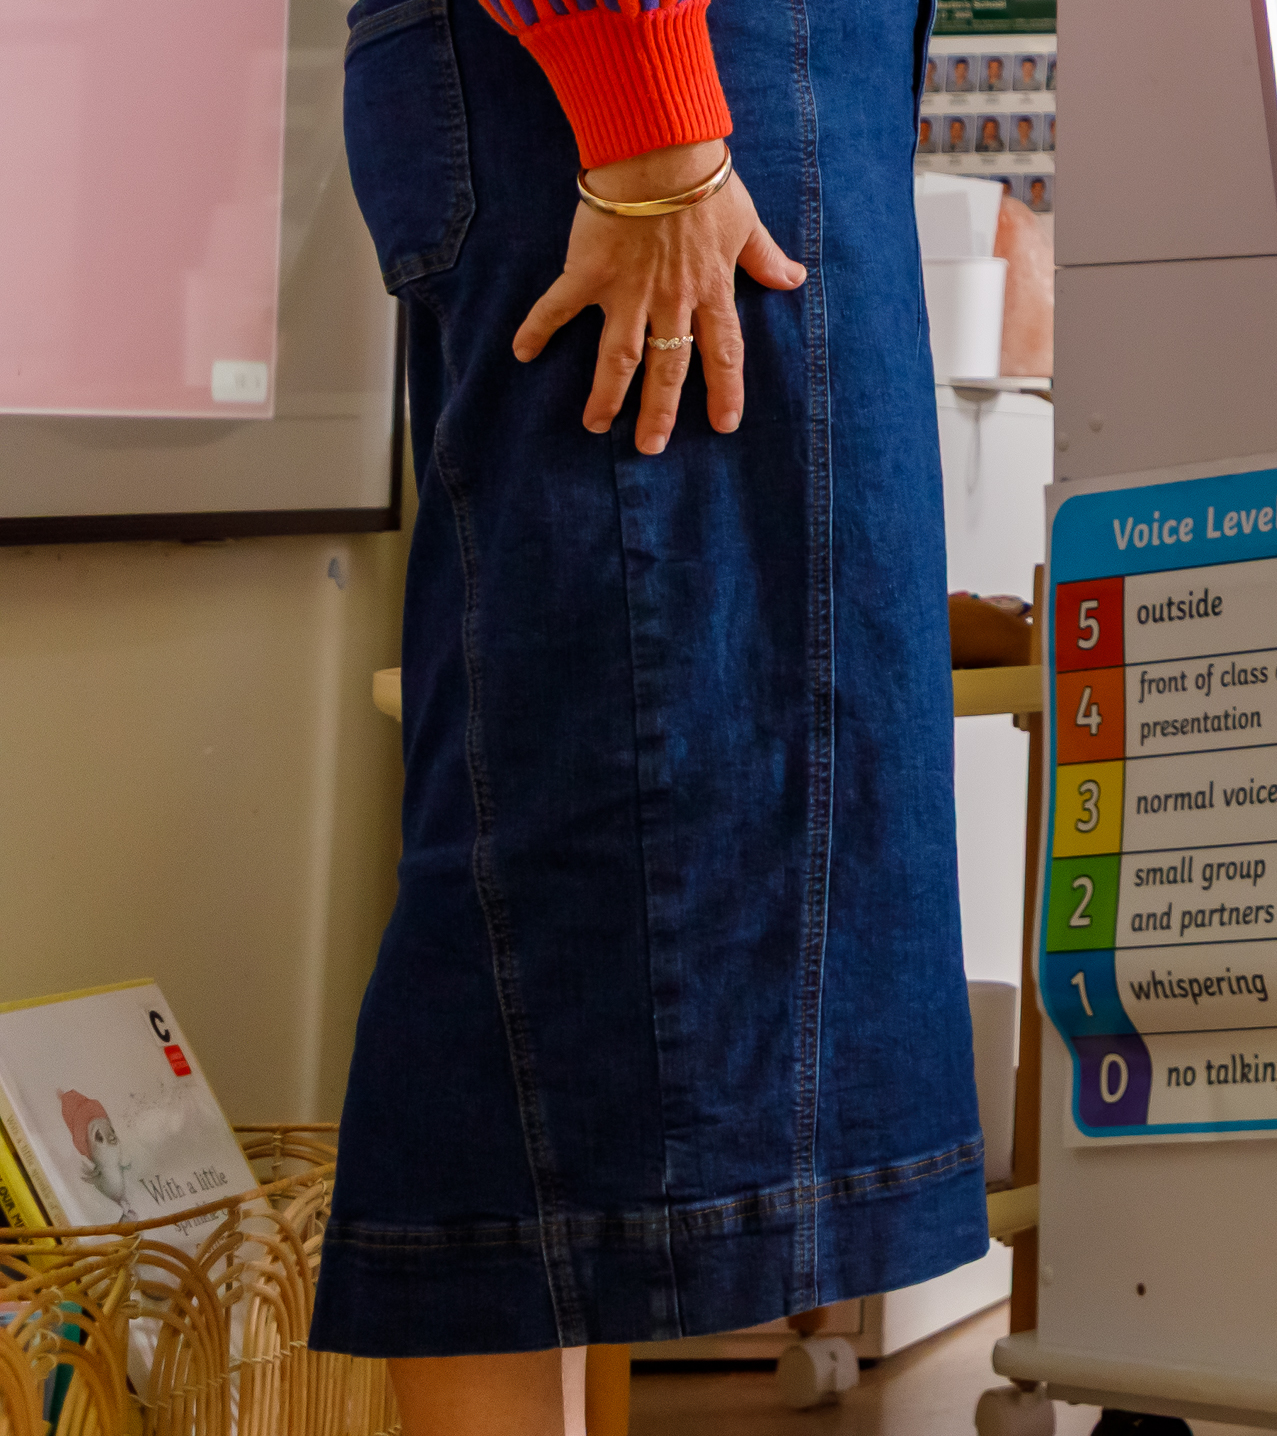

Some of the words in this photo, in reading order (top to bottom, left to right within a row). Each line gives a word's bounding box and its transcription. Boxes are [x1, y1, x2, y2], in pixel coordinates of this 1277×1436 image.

[1113, 510, 1195, 551] Voice
[1076, 598, 1100, 650] 5
[1136, 587, 1224, 625] outside
[1138, 670, 1189, 703] front
[1195, 663, 1215, 697] of
[1220, 661, 1269, 688] class
[1075, 686, 1103, 737] 4
[1140, 706, 1262, 746] presentation
[1074, 779, 1101, 834] 3
[1136, 780, 1214, 815] normal
[1134, 856, 1193, 888] small
[1202, 858, 1266, 891] group
[1067, 875, 1096, 930] 2
[1131, 902, 1172, 933] and
[1180, 903, 1275, 937] partners
[1070, 971, 1094, 1018] 1
[1129, 968, 1268, 1006] whispering
[149, 1010, 171, 1043] C
[1099, 1052, 1130, 1105] 0
[1167, 1065, 1196, 1088] no
[138, 1174, 187, 1207] With
[186, 1180, 198, 1195] a
[193, 1165, 229, 1192] little
